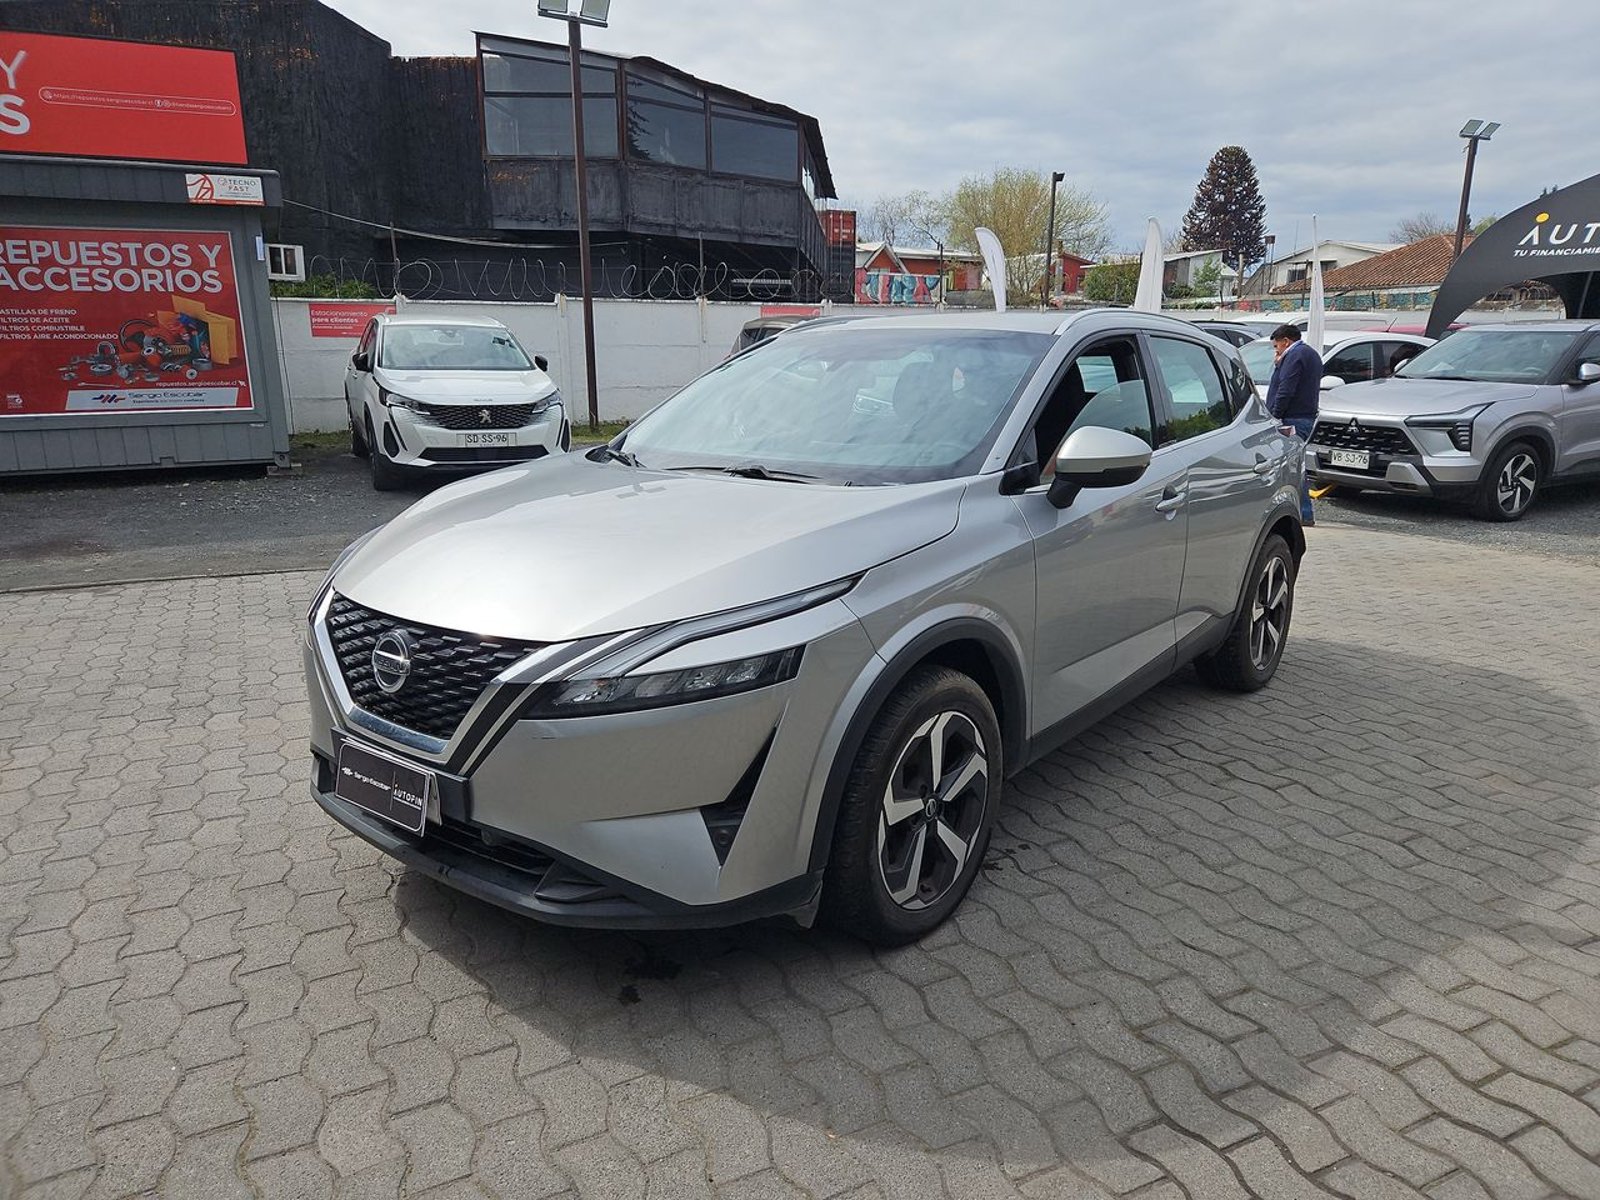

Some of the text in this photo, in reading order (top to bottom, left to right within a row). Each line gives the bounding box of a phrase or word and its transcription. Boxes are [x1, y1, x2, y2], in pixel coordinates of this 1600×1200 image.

[228, 178, 256, 187] TECNO
[0, 239, 222, 268] EPUESTOS Y
[1513, 249, 1528, 257] TU
[311, 309, 369, 318] Estacionamiento
[311, 316, 359, 325] para clientes
